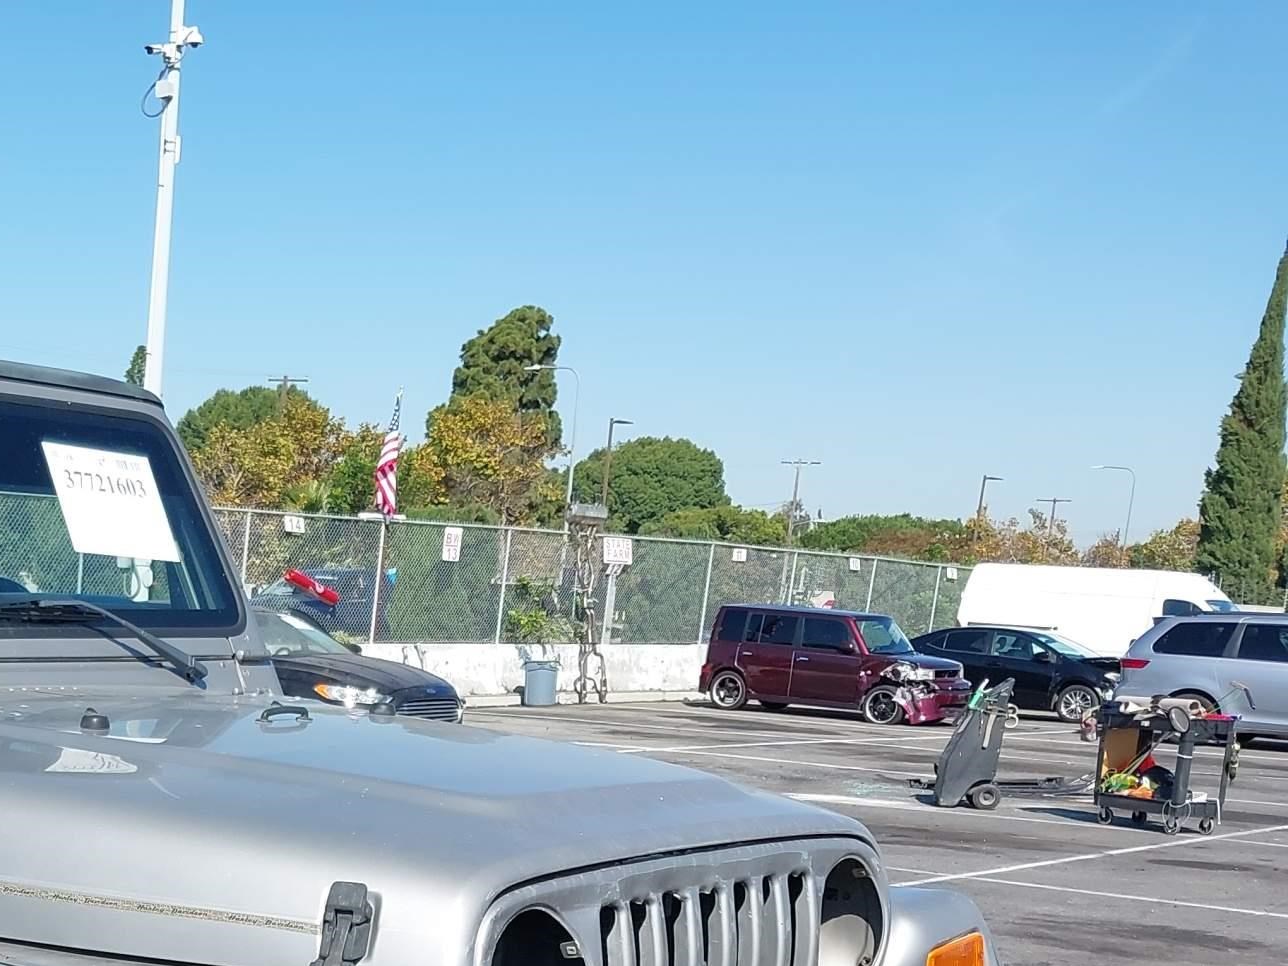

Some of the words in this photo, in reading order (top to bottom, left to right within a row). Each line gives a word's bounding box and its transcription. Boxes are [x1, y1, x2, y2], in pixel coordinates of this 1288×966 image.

[63, 469, 147, 499] 37721603
[289, 518, 302, 530] 14
[446, 548, 458, 560] 13
